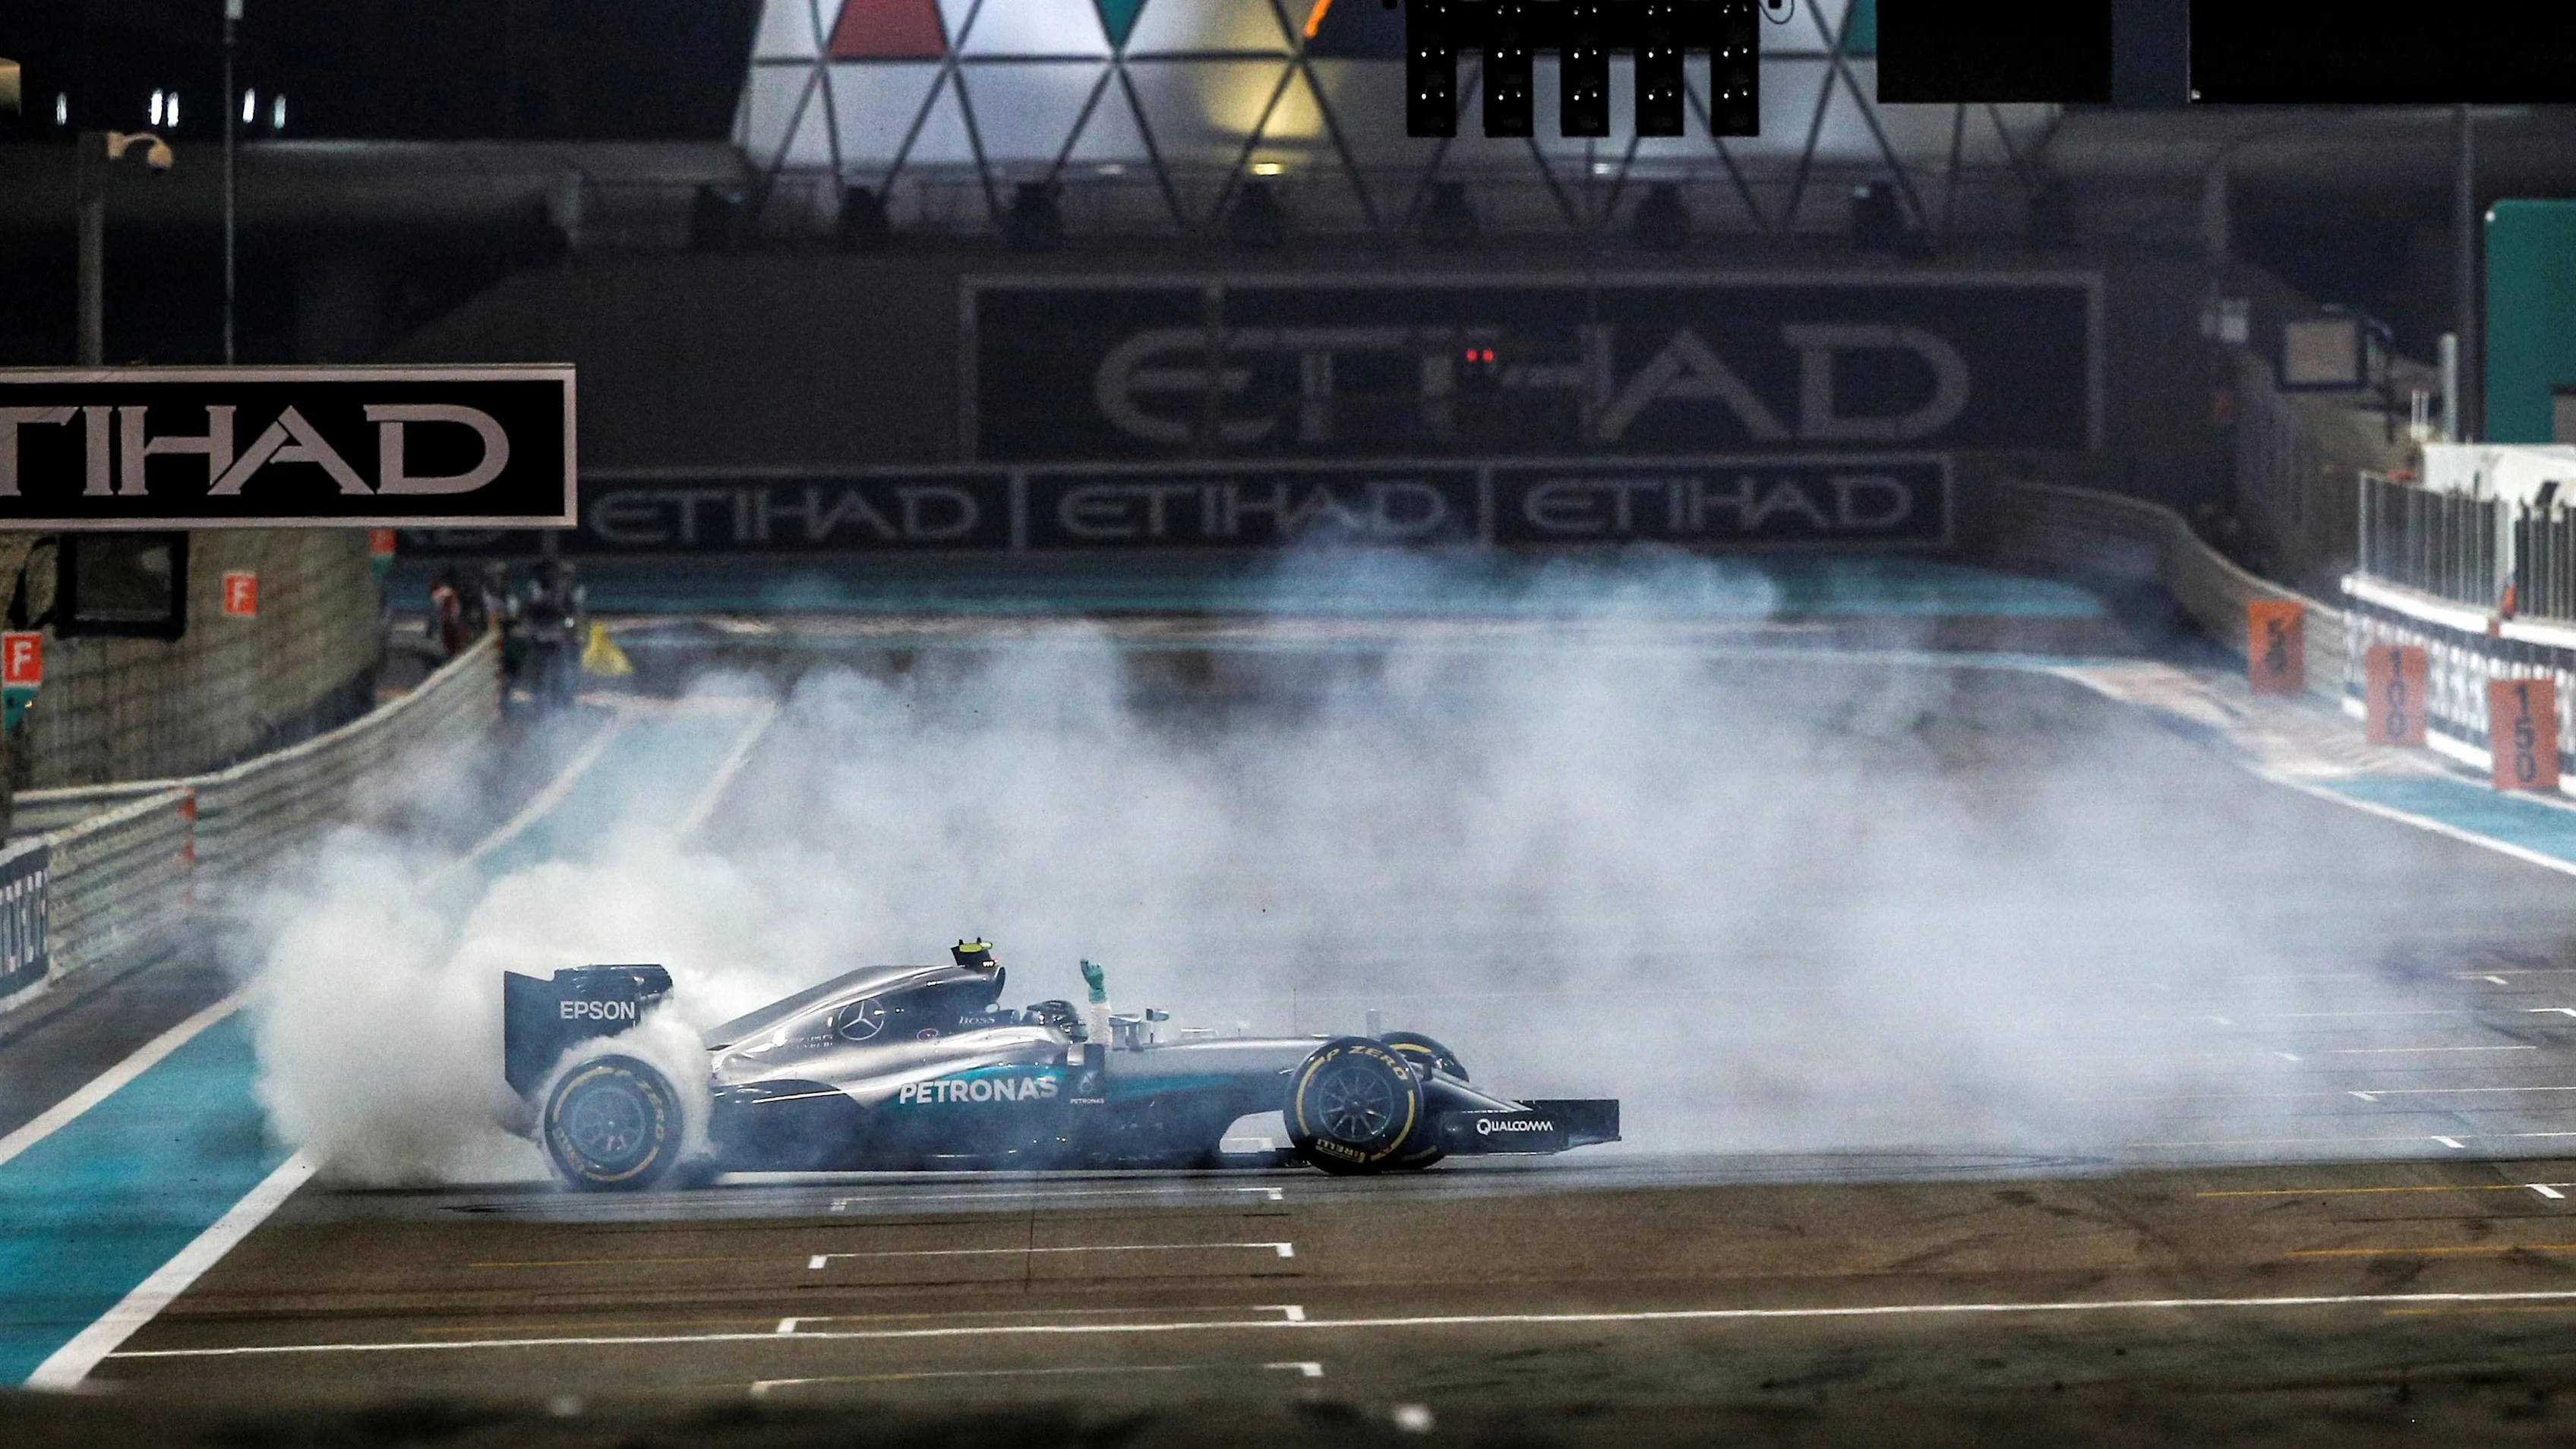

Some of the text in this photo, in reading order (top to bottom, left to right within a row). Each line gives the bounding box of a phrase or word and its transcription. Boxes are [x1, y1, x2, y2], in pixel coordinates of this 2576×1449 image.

[1092, 323, 1971, 442] ETIHAD
[589, 485, 981, 544] ETIHAD
[1058, 482, 1446, 538] ETIHAD
[1523, 476, 1914, 530] ETIHAD
[231, 579, 250, 608] F
[13, 640, 32, 677] F
[2514, 684, 2538, 784] 150
[560, 1000, 635, 1021] EPSON
[1326, 1045, 1409, 1081] P ZERO
[899, 1075, 1059, 1104] PETRONAS
[1476, 1118, 1554, 1136] QUALCOMM
